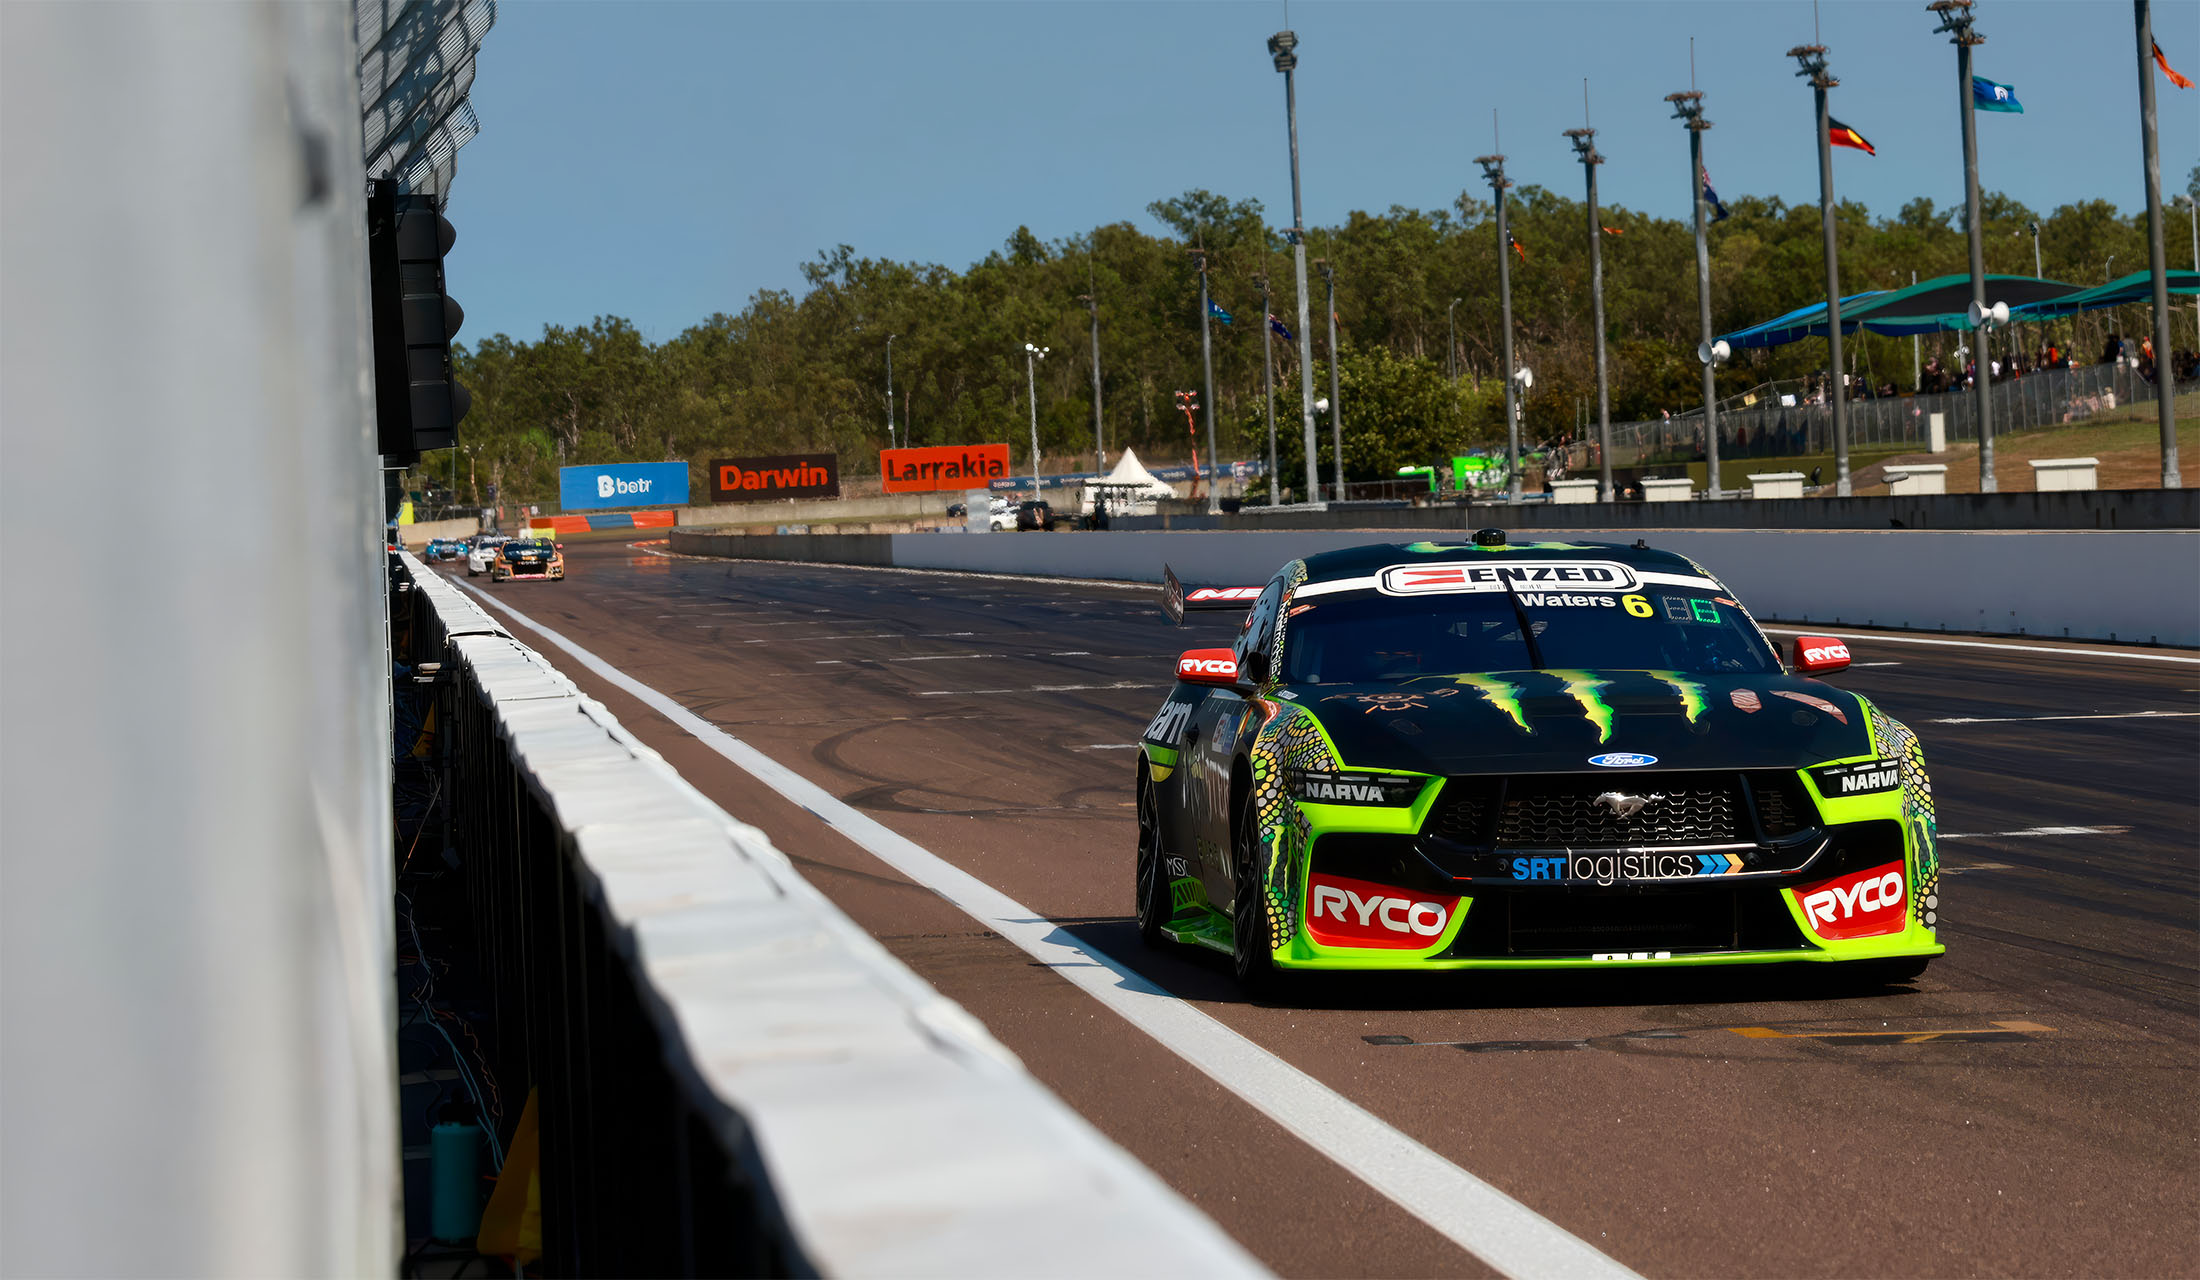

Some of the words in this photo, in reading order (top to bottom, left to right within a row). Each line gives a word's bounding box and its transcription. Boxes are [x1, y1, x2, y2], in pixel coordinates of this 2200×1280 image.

[887, 450, 1004, 482] Larrakia
[719, 464, 829, 493] Darwin
[1468, 567, 1615, 583] ENZED
[1516, 592, 1616, 608] Waters
[1621, 594, 1654, 618] 6
[1803, 645, 1851, 662] RYCO
[1178, 658, 1237, 674] RYCO
[1601, 752, 1645, 765] Ford
[1306, 782, 1385, 802] NARVA
[1842, 769, 1899, 792] NARVA
[1313, 884, 1447, 937] RYCO
[1803, 871, 1904, 931] RYCO
